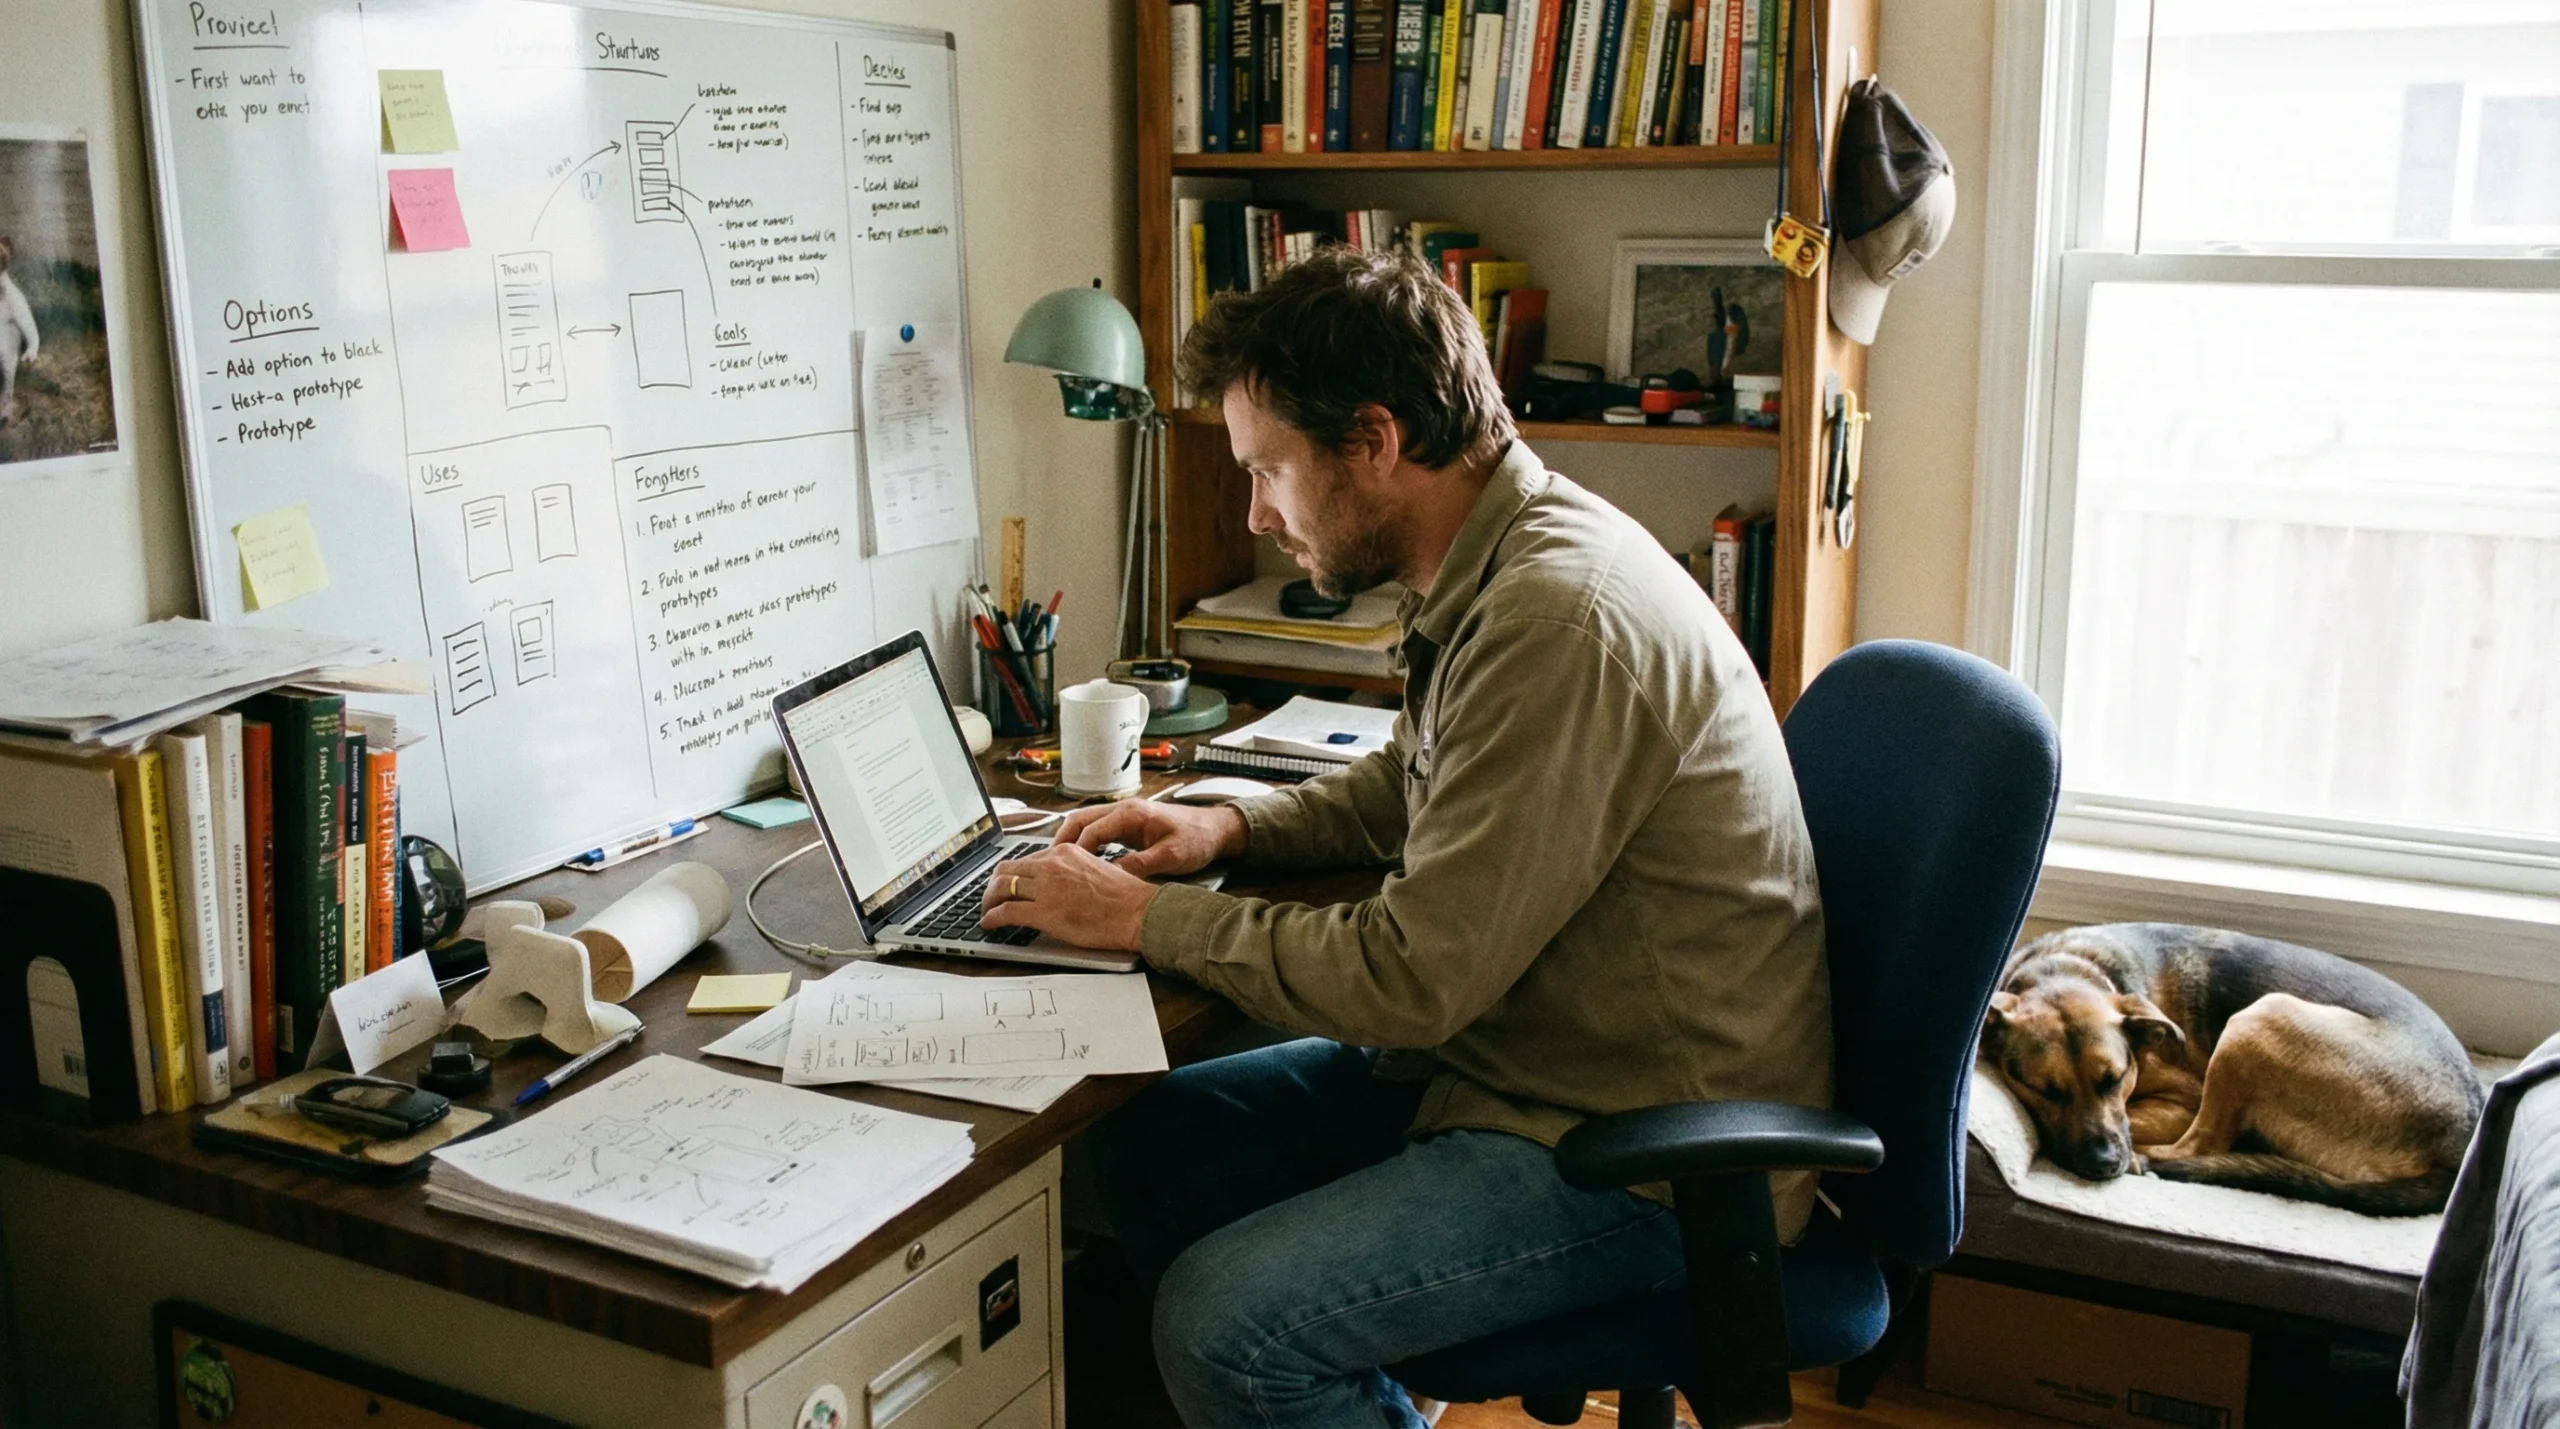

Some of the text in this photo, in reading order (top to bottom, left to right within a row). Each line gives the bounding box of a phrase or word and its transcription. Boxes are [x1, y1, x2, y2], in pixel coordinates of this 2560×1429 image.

[191, 65, 306, 89] First want to
[240, 103, 268, 124] you
[224, 299, 313, 338] Options
[226, 357, 255, 379] Add
[264, 352, 313, 376] option
[321, 346, 337, 364] to
[293, 376, 364, 406] prototype
[238, 416, 317, 444] Prototype
[420, 463, 459, 486] Uses
[740, 490, 752, 510] of
[793, 481, 817, 503] your
[689, 565, 699, 580] in
[755, 547, 765, 561] in
[768, 540, 785, 556] the
[660, 585, 719, 619] prototypes
[785, 580, 838, 612] prototypes
[671, 645, 696, 668] with
